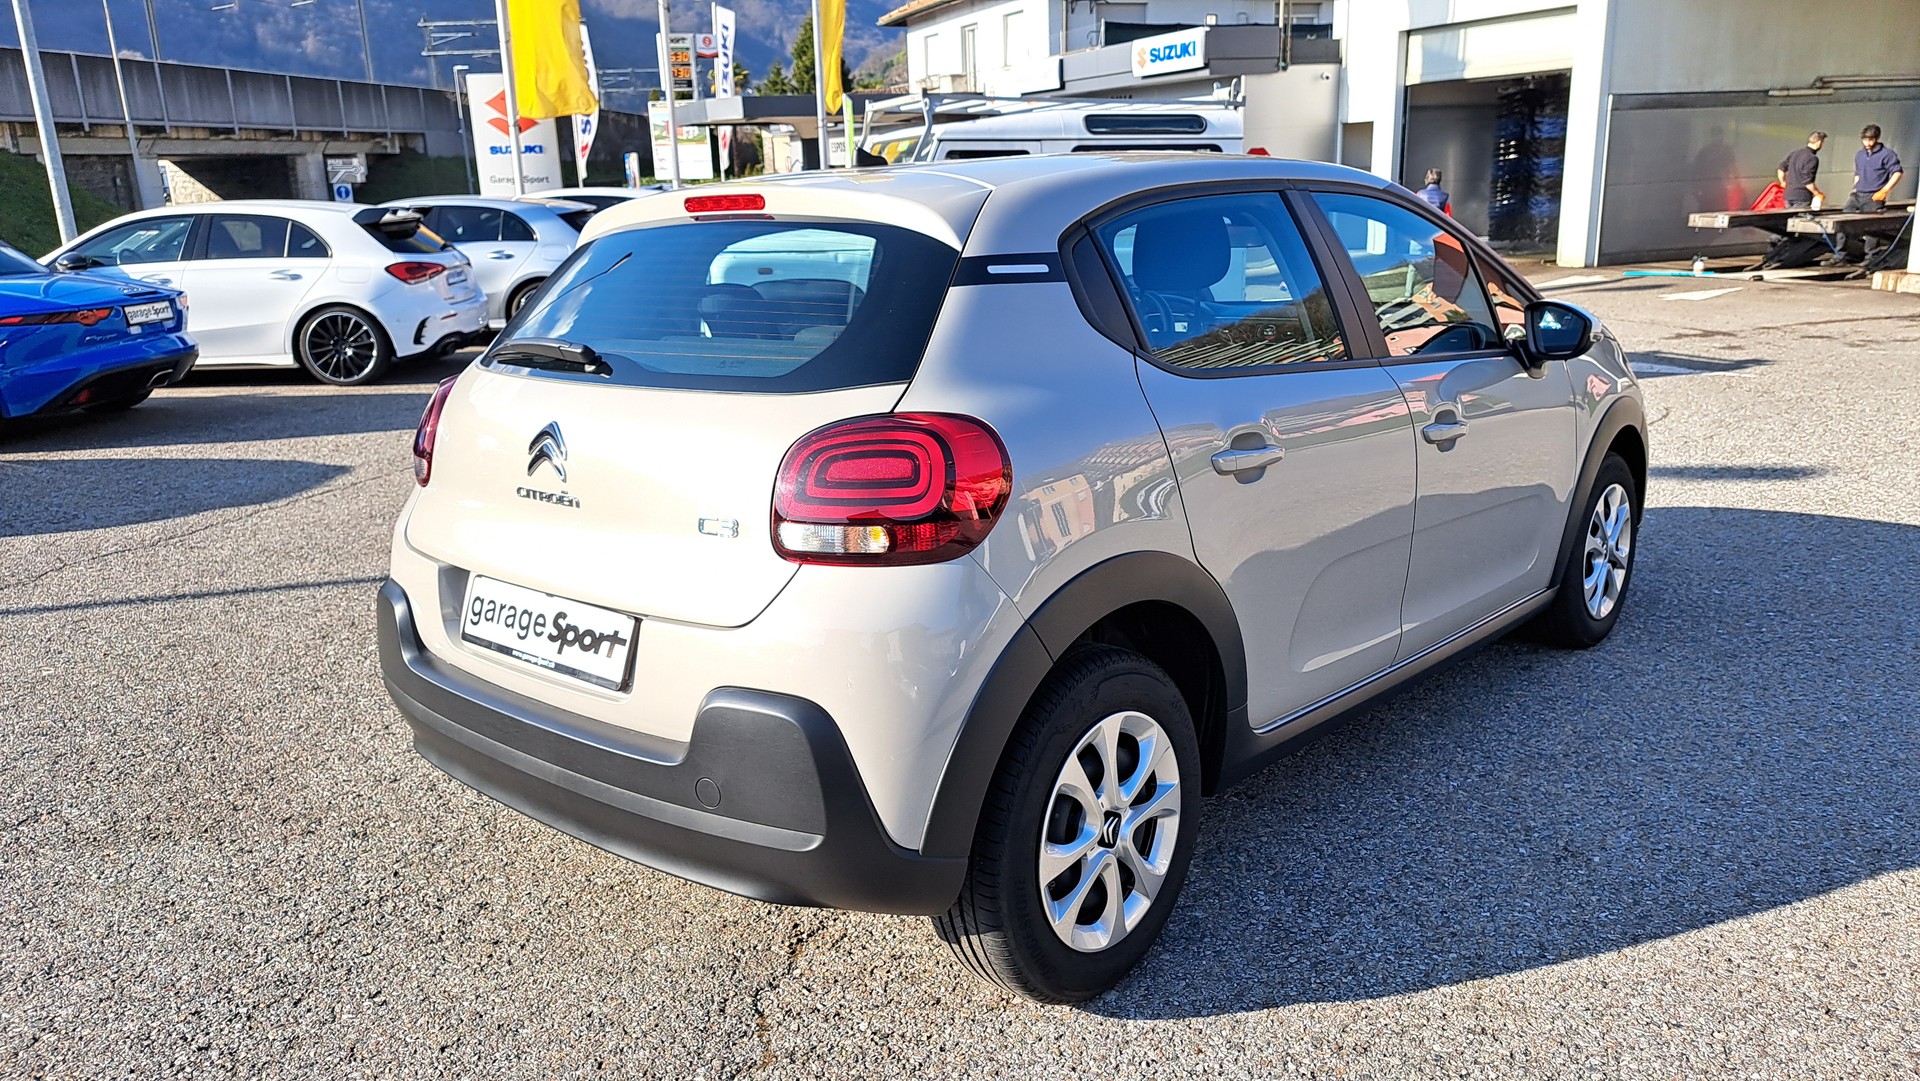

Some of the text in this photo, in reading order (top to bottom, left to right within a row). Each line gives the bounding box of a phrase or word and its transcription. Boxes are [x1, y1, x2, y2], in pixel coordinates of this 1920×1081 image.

[1149, 41, 1196, 63] SUZUKI
[489, 175, 550, 185] Garag Sport
[698, 517, 739, 538] C3
